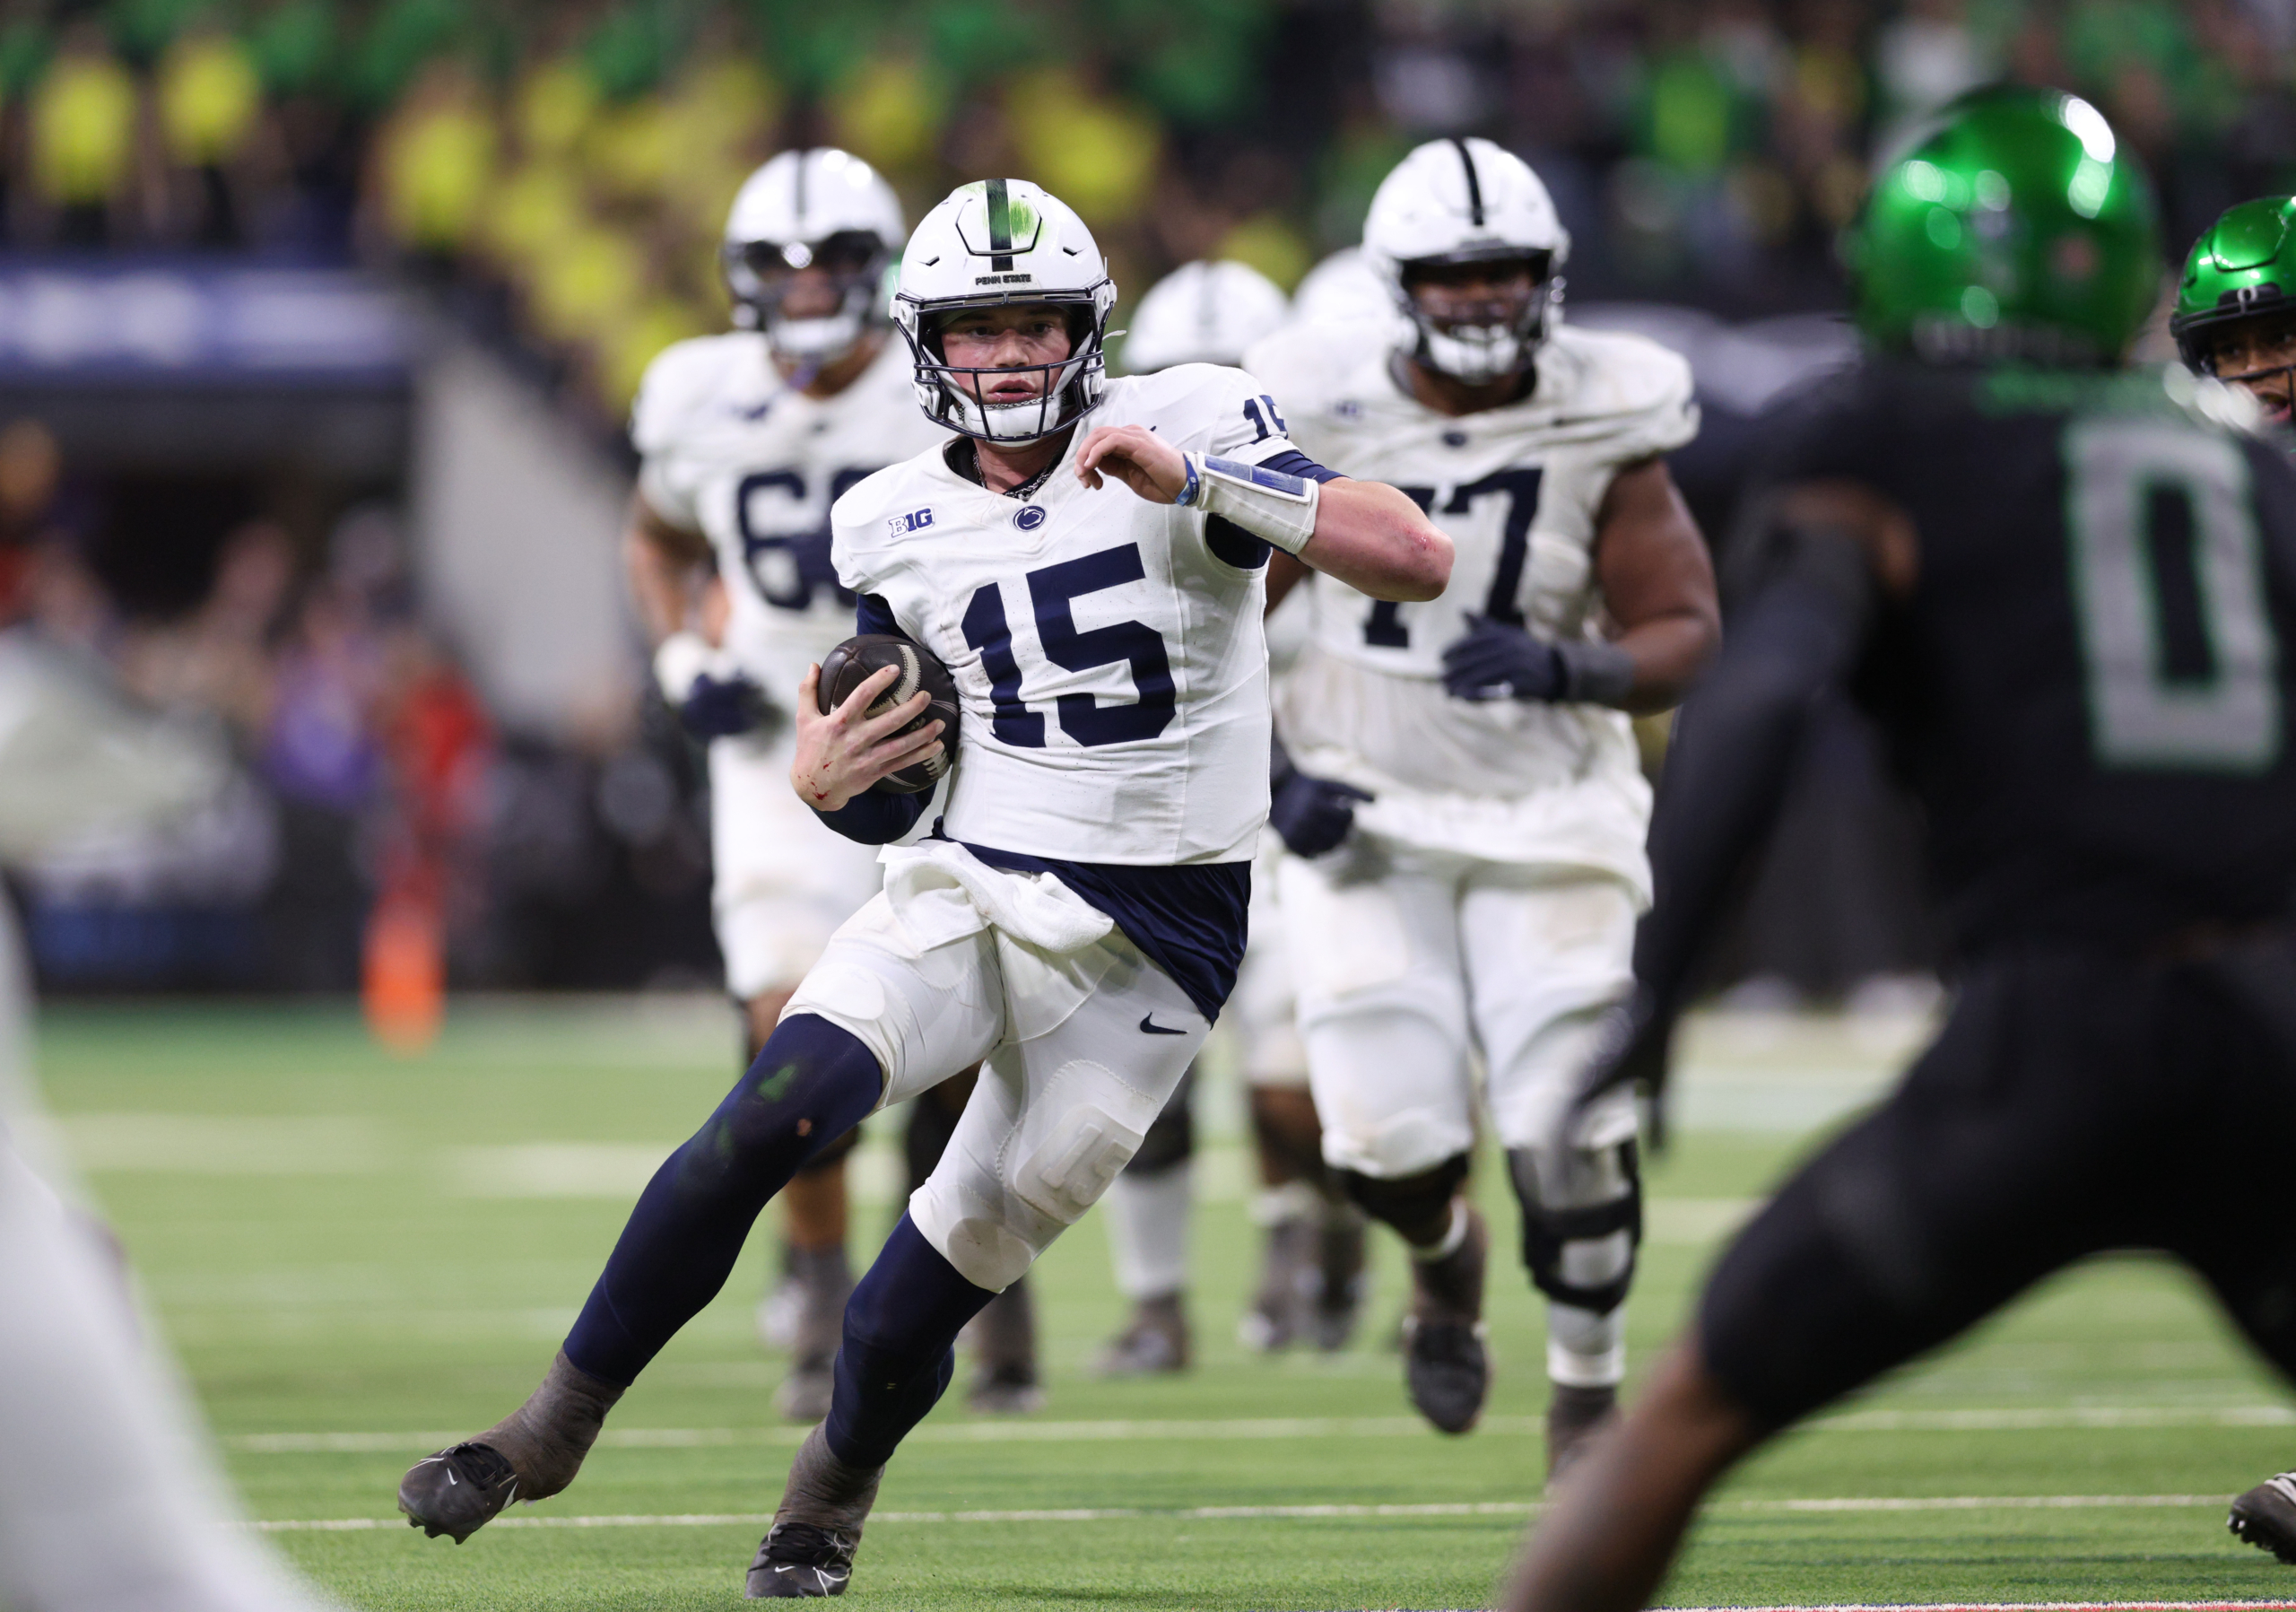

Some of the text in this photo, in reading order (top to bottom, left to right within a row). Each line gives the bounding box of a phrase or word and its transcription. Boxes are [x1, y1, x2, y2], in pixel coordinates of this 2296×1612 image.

[975, 274, 1031, 285] PENN STATE
[961, 542, 1177, 748] 15
